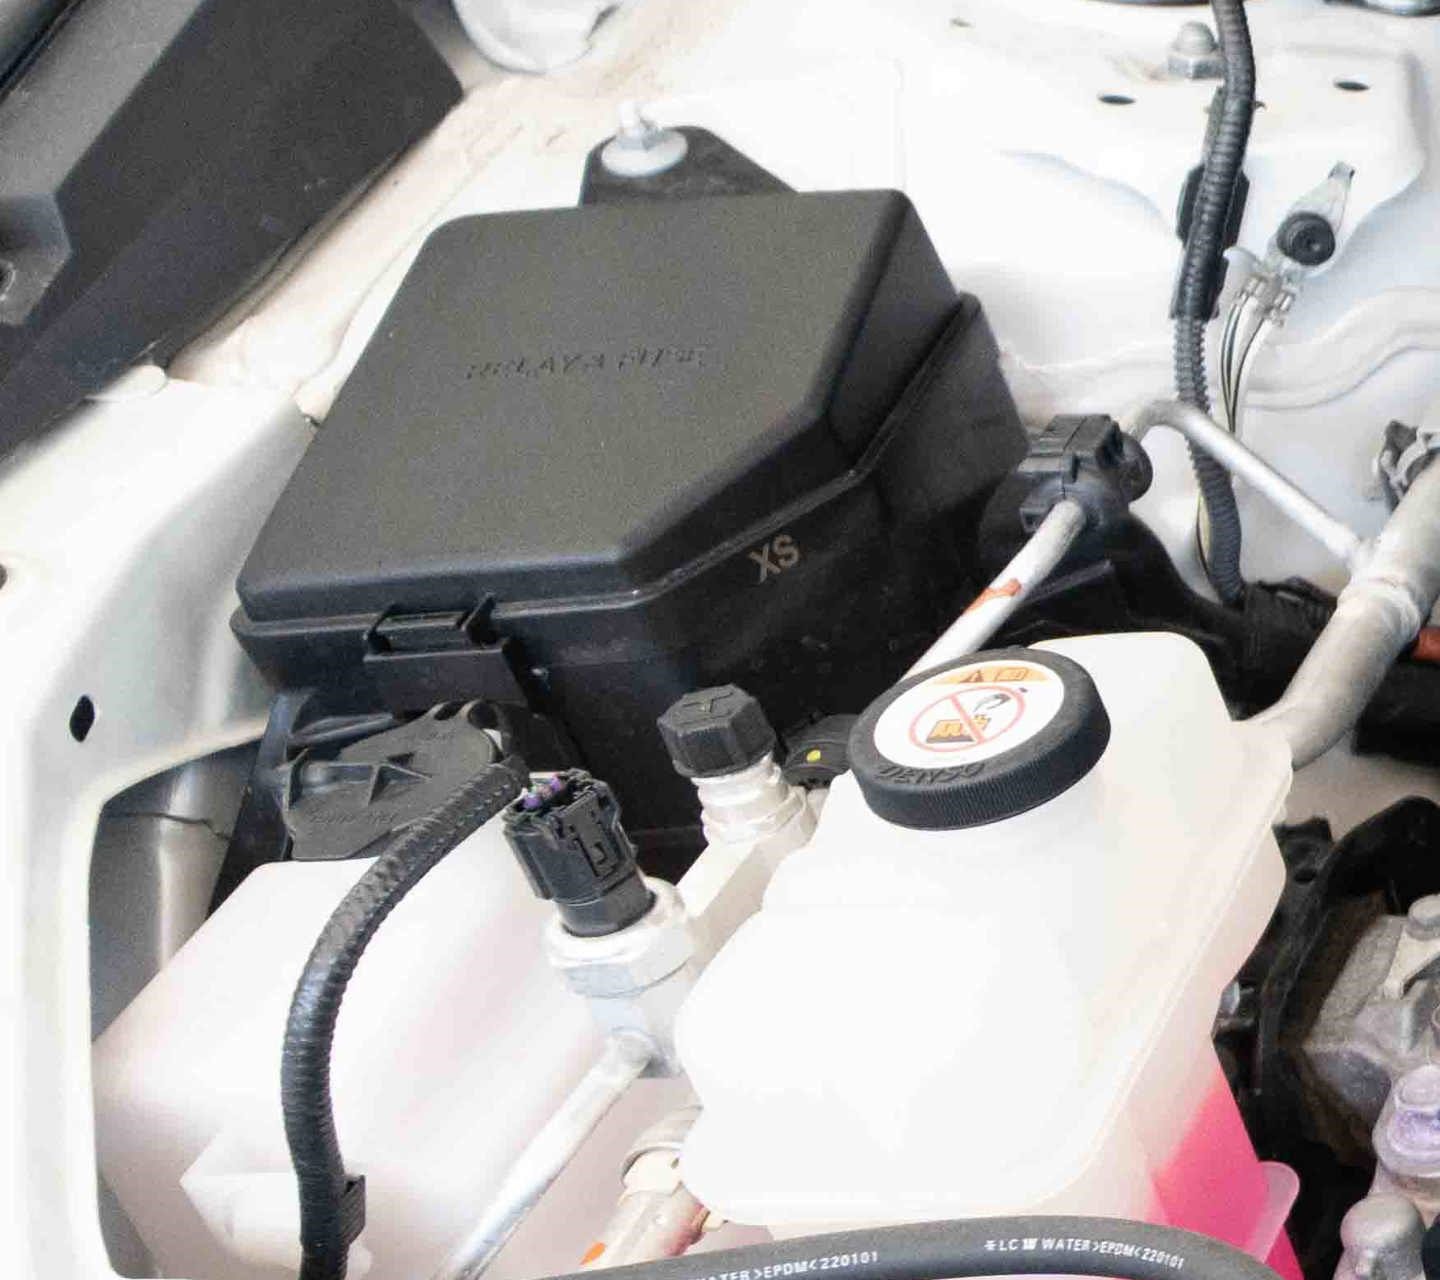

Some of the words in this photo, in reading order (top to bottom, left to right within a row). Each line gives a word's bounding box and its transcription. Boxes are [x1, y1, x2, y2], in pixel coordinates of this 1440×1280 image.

[746, 534, 803, 583] XS
[875, 762, 988, 786] DENSO
[819, 1251, 878, 1271] 220101
[1042, 1238, 1091, 1253] WATER
[1142, 1246, 1185, 1271] 220101
